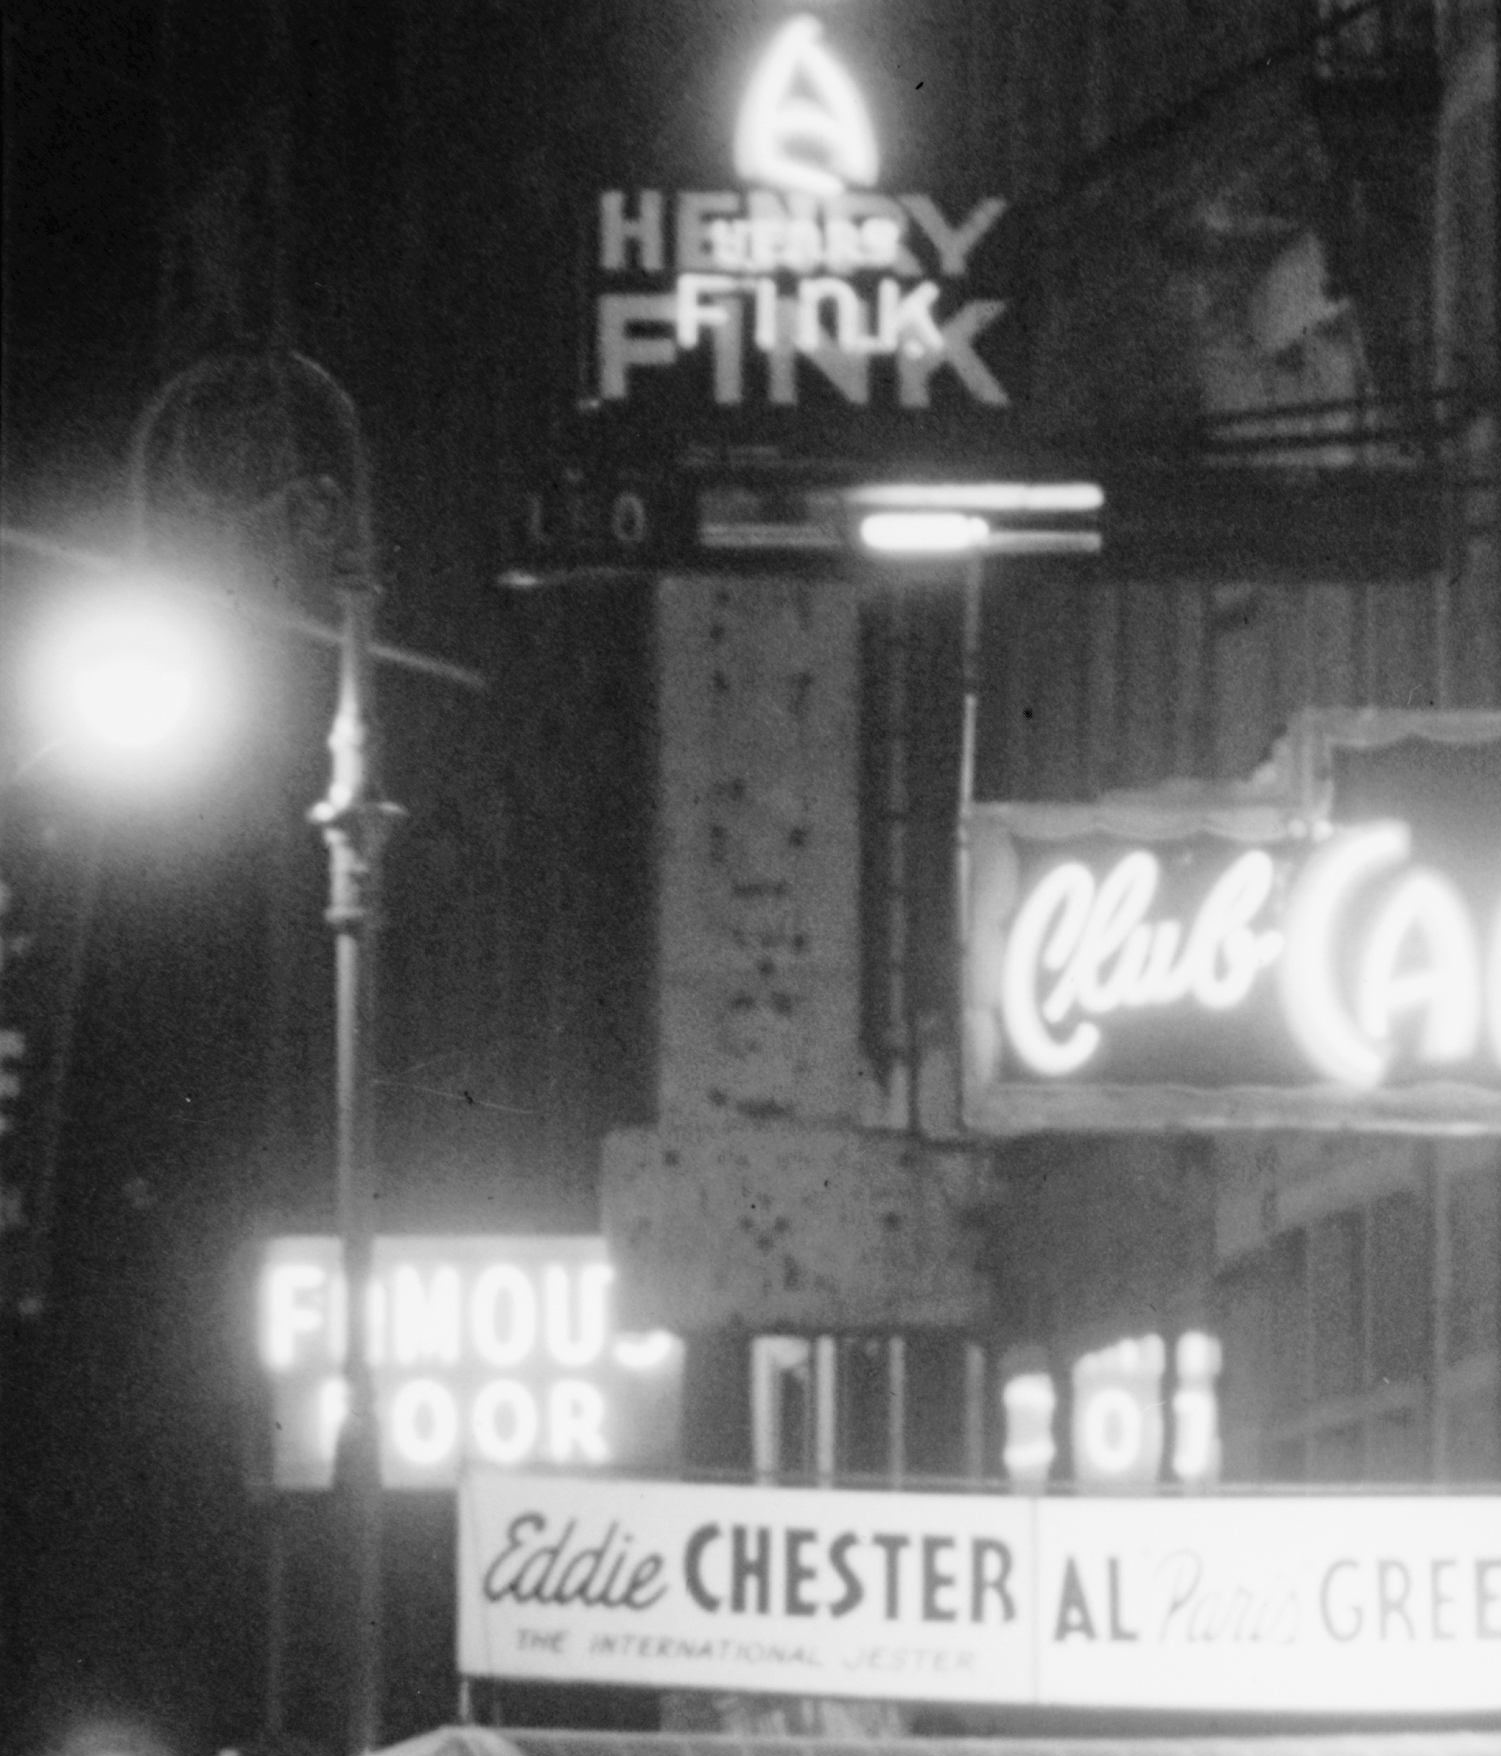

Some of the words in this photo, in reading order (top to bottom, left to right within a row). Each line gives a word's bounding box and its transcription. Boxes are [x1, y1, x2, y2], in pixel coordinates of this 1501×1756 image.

[1006, 849, 1286, 1076] Club
[260, 1262, 676, 1372] FMOU
[482, 1512, 669, 1612] Eddie
[682, 1521, 1018, 1625] CHESTER
[1052, 1555, 1140, 1644] AL
[515, 1627, 572, 1656] THE
[588, 1632, 824, 1670] INTERNATIONAL
[841, 1643, 978, 1677] JESTER
